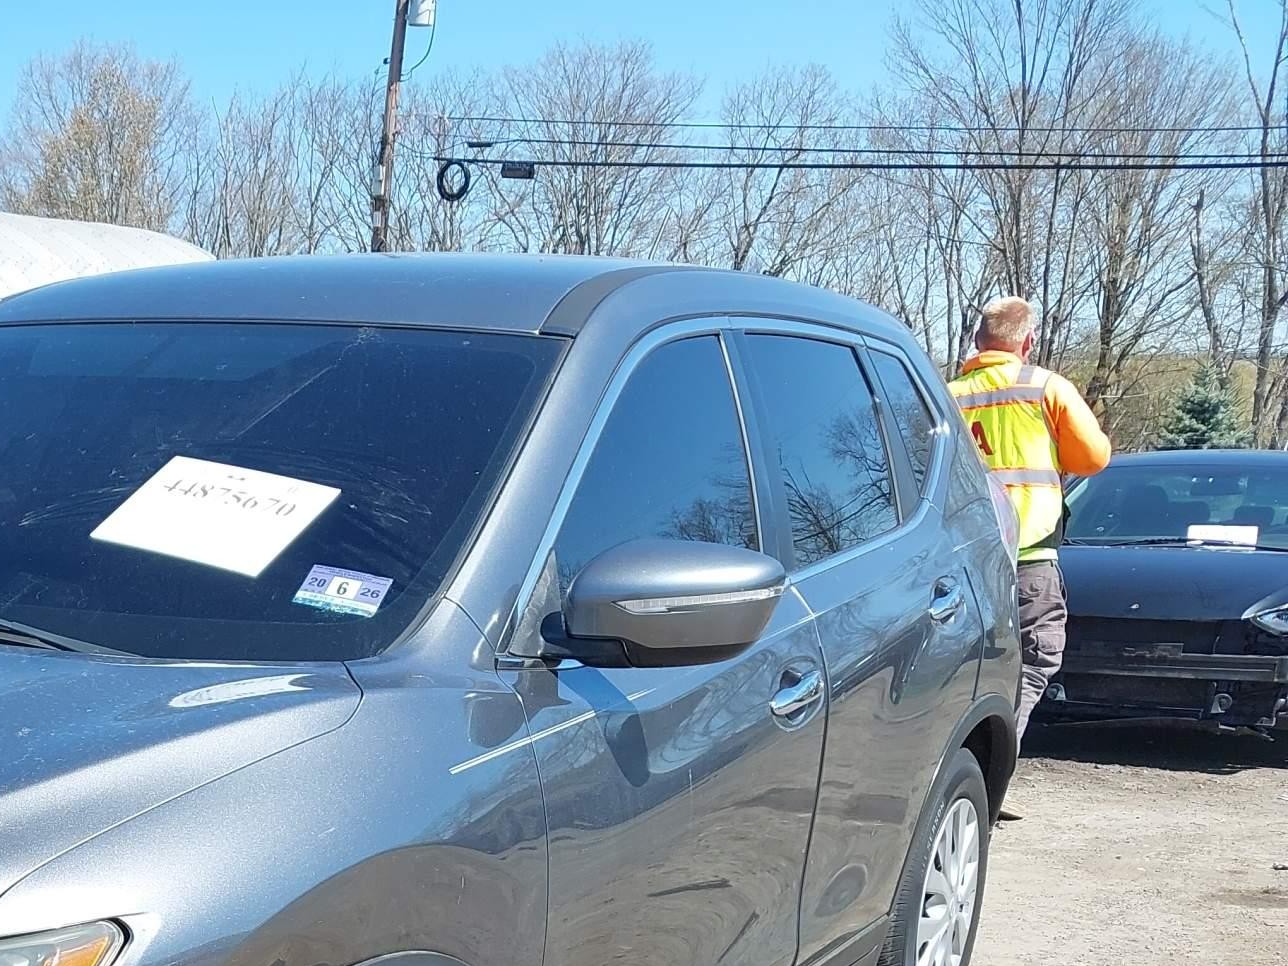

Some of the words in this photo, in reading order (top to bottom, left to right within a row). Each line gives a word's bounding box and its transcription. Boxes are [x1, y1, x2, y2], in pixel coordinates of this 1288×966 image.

[163, 480, 296, 516] 44875670
[307, 577, 327, 588] 20
[336, 581, 350, 595] 6
[360, 587, 381, 599] 26
